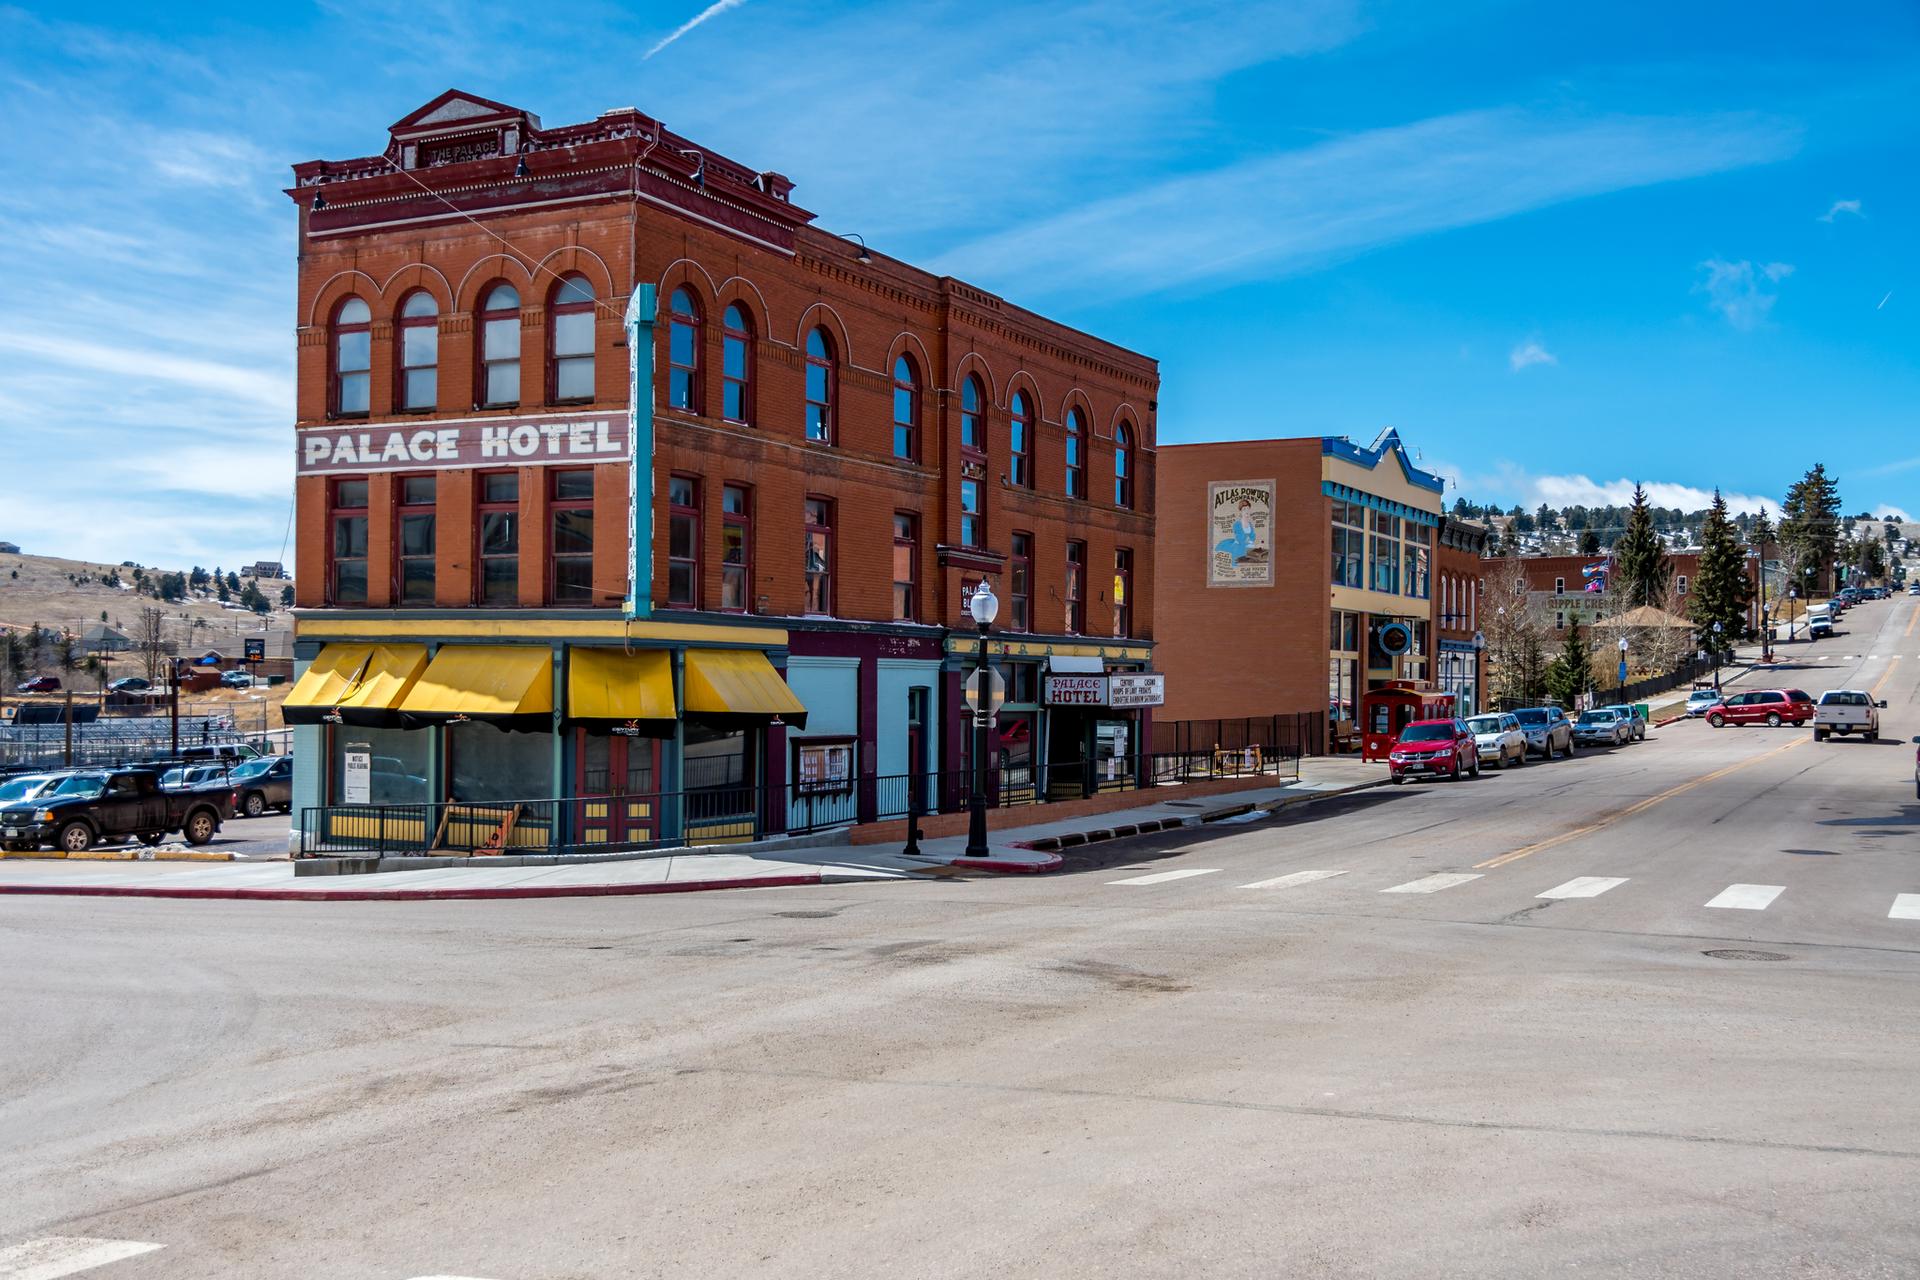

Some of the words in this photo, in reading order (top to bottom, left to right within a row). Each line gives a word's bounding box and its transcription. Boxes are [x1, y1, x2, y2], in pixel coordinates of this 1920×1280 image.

[431, 147, 452, 160] THE
[455, 141, 496, 156] PALACE
[305, 429, 460, 465] PALACE
[481, 421, 622, 457] HOTEL
[1214, 489, 1239, 509] ATLAS
[1240, 487, 1270, 509] POWDER
[1230, 494, 1260, 504] COMPANY
[1053, 679, 1101, 690] PALACE
[1051, 690, 1102, 703] HOTEL
